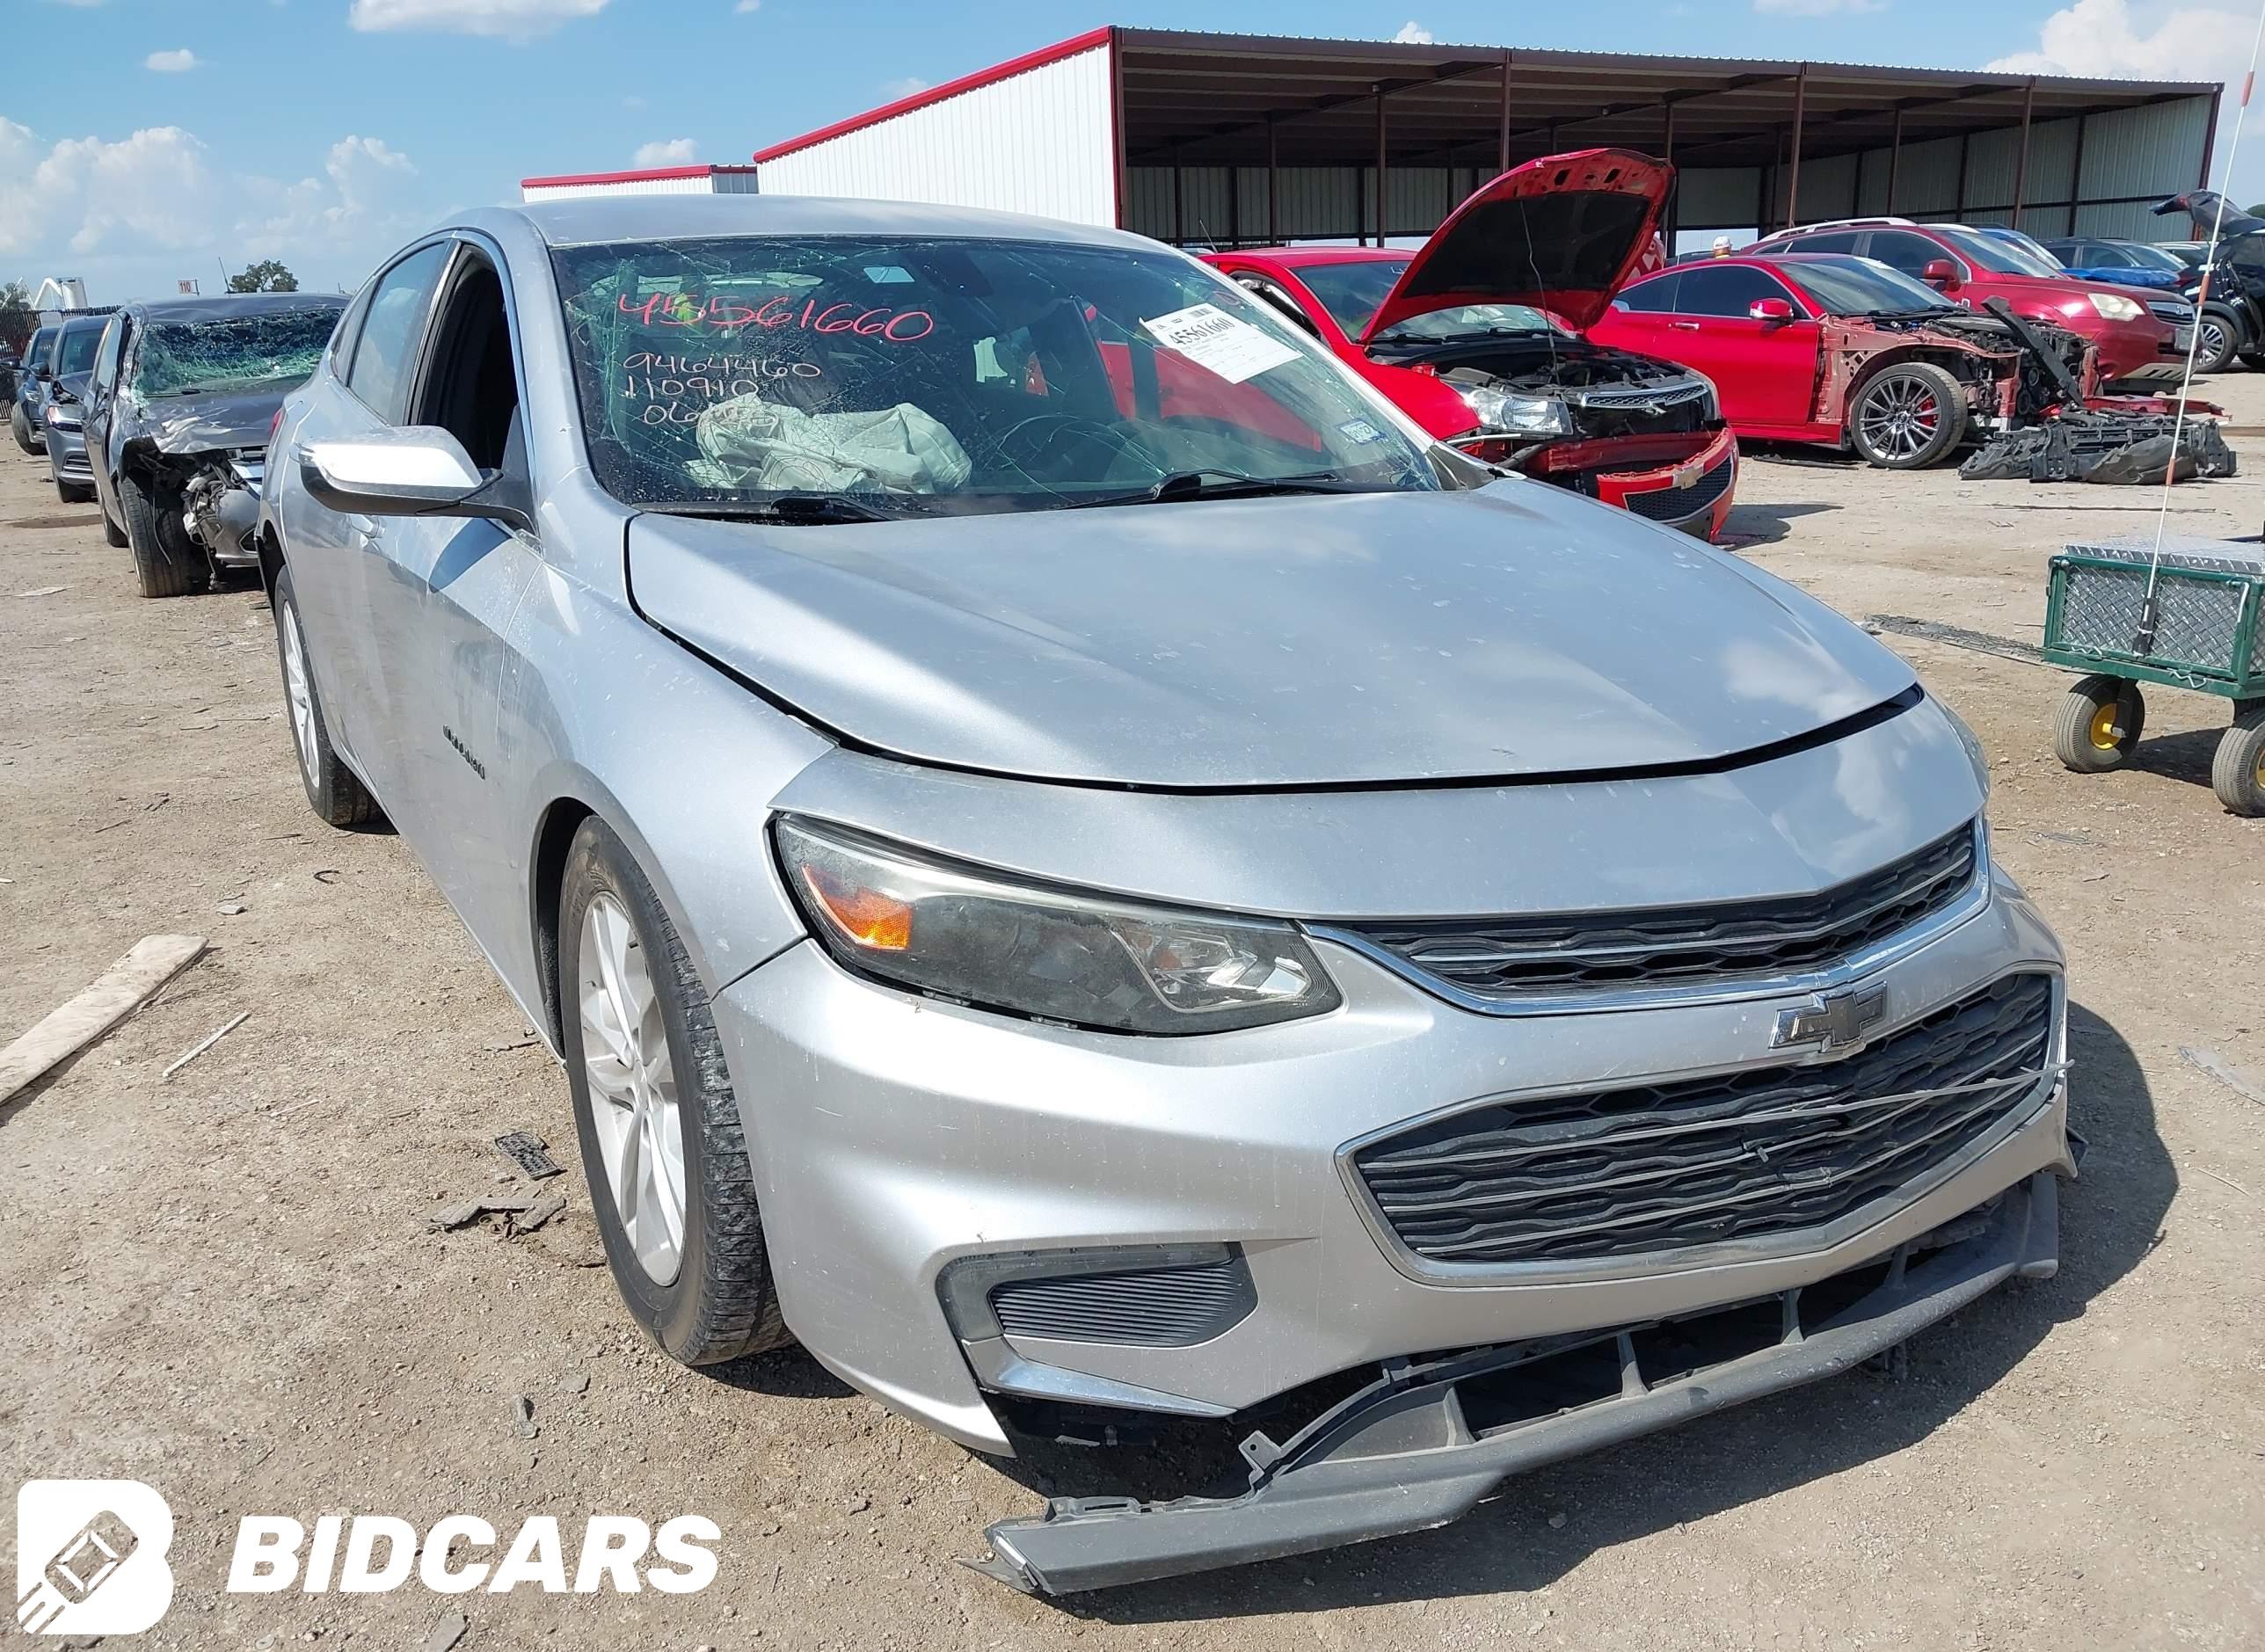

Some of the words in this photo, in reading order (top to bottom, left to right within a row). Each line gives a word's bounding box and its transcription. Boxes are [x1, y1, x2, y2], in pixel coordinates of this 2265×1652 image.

[619, 294, 934, 341] 45561660
[1169, 317, 1234, 345] 45561660
[623, 353, 821, 378] 9464460
[627, 375, 759, 401] 110910
